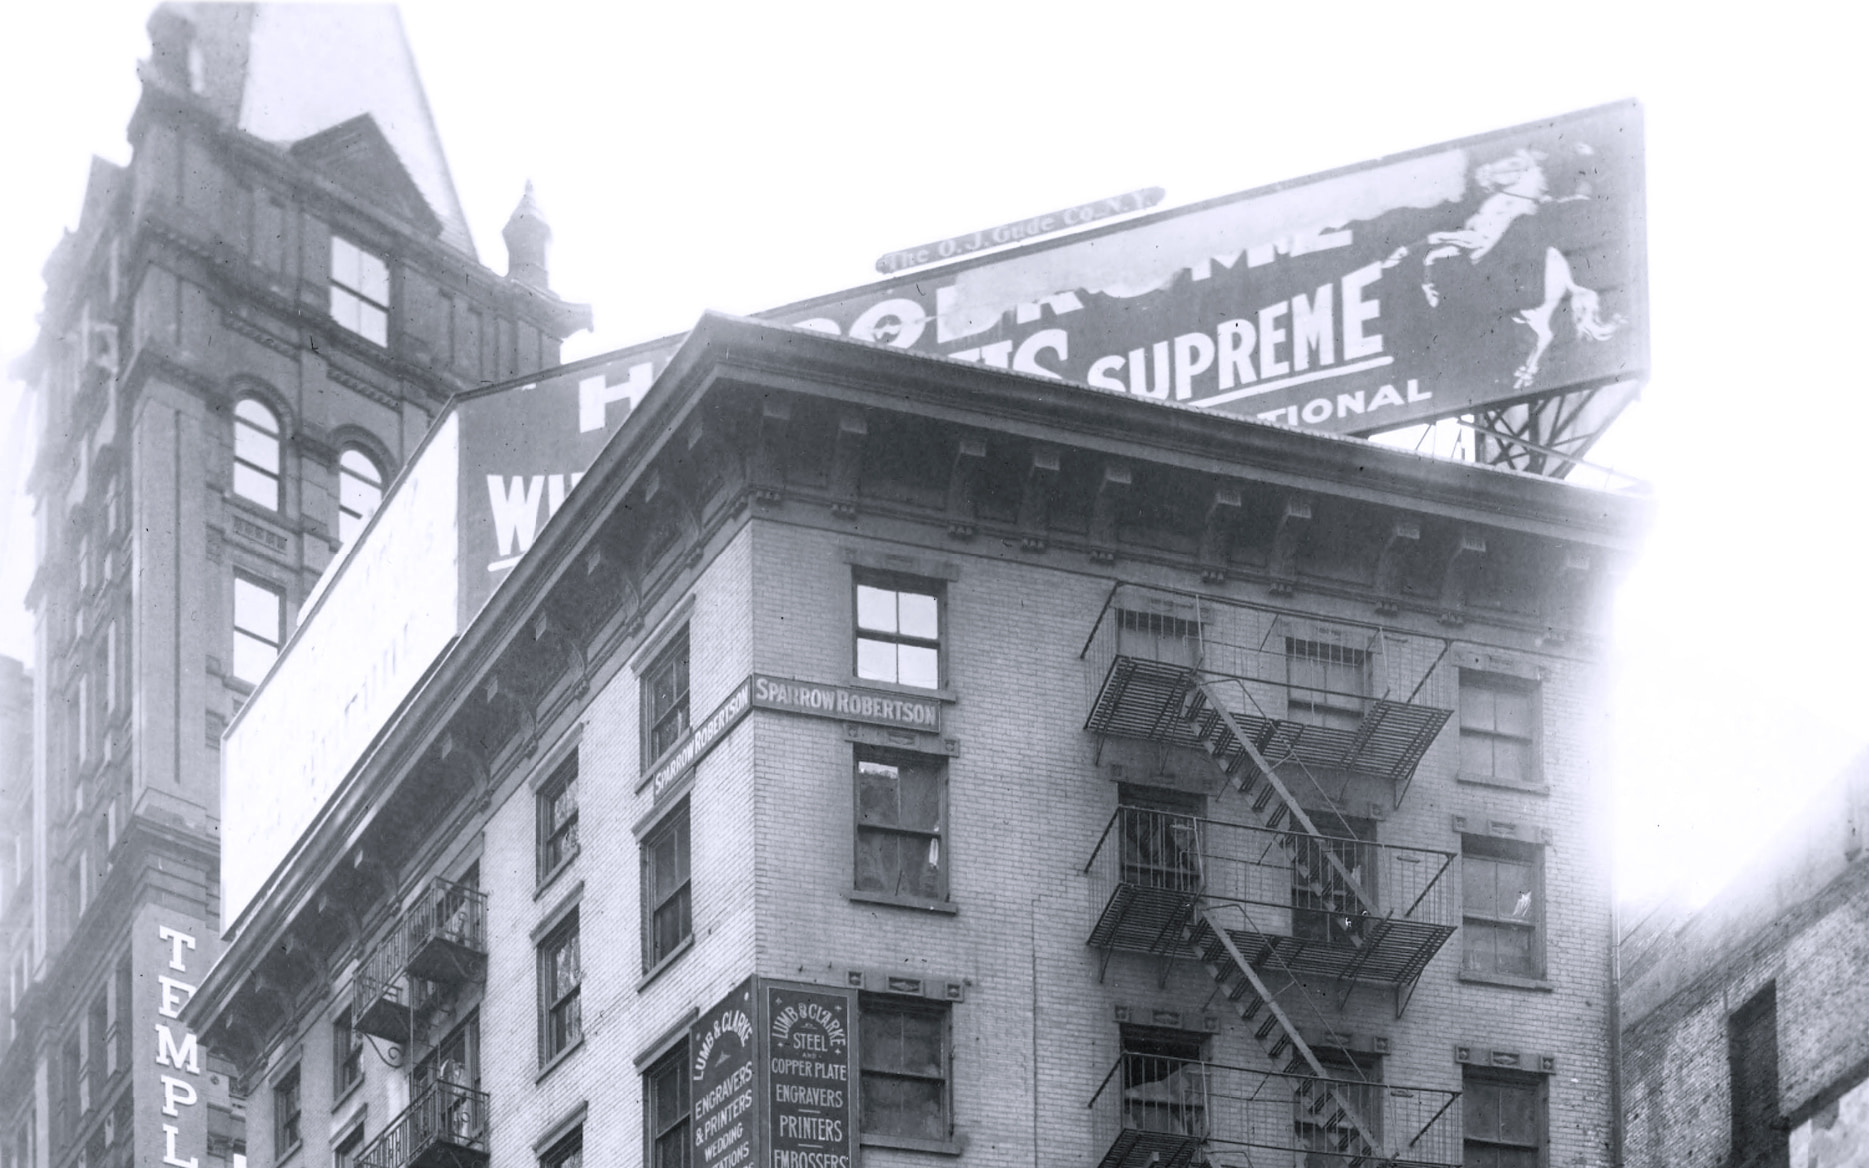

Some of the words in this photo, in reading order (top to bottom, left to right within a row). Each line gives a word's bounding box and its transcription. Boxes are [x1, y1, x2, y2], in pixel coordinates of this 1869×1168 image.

[886, 245, 928, 270] The
[992, 215, 1055, 243] Gude
[1088, 261, 1384, 402] SUPREME
[693, 1030, 715, 1081] LUMB
[713, 1019, 723, 1041] &
[721, 1009, 754, 1048] CLARKE
[772, 1004, 799, 1040] LUMB
[798, 1002, 808, 1019] &
[808, 1003, 847, 1047] CLARKE
[792, 1032, 829, 1053] STEEL
[695, 1060, 754, 1122] ENGRAVERS
[771, 1057, 812, 1079] COPPER
[814, 1062, 848, 1082] PLATE
[694, 1126, 705, 1147] &
[704, 1088, 754, 1141] PRINTERS
[775, 1083, 845, 1109] ENGRAVERS
[704, 1121, 744, 1163] WEDDING
[779, 1113, 844, 1143] PRINTERS
